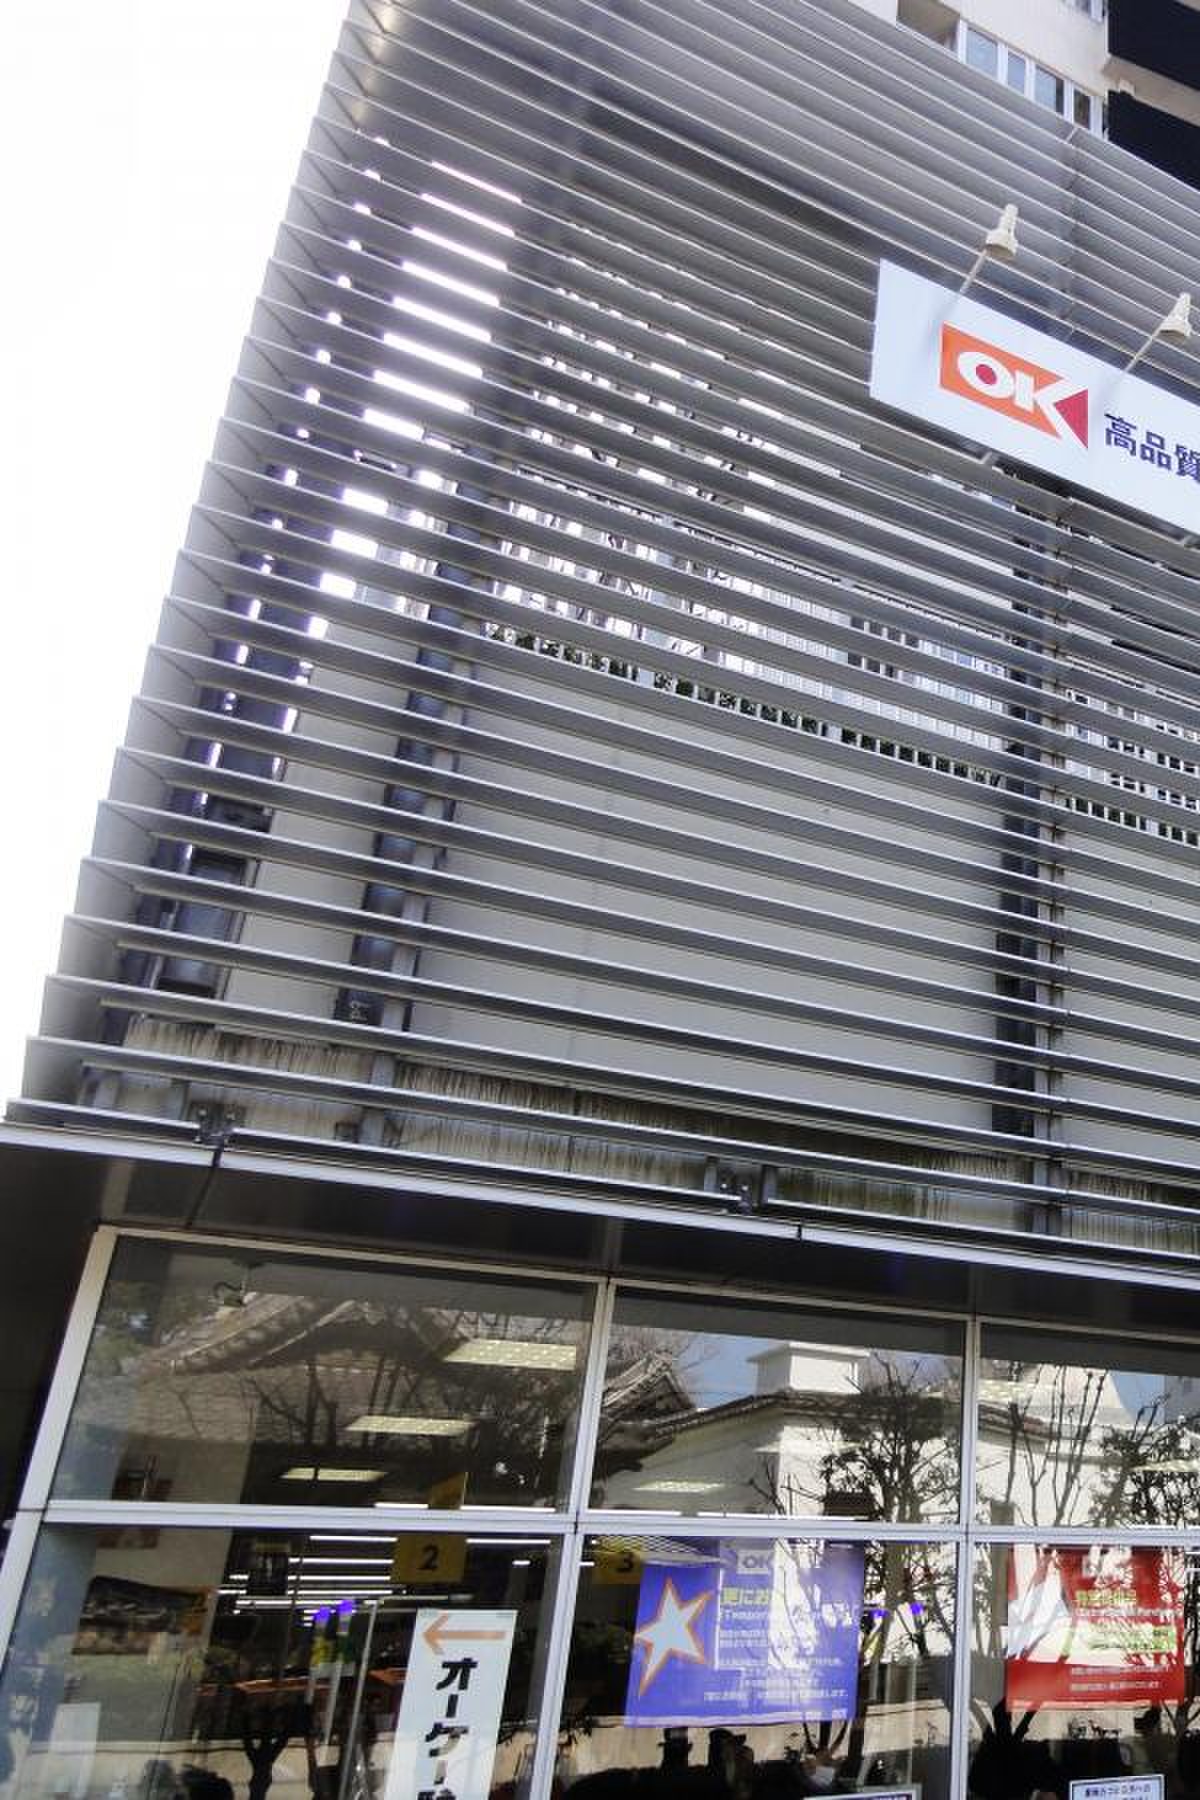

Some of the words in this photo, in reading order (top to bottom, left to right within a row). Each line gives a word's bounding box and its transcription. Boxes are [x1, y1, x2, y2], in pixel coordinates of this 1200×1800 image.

[956, 350, 1089, 449] OK
[421, 1544, 439, 1571] 2
[617, 1552, 634, 1573] 3
